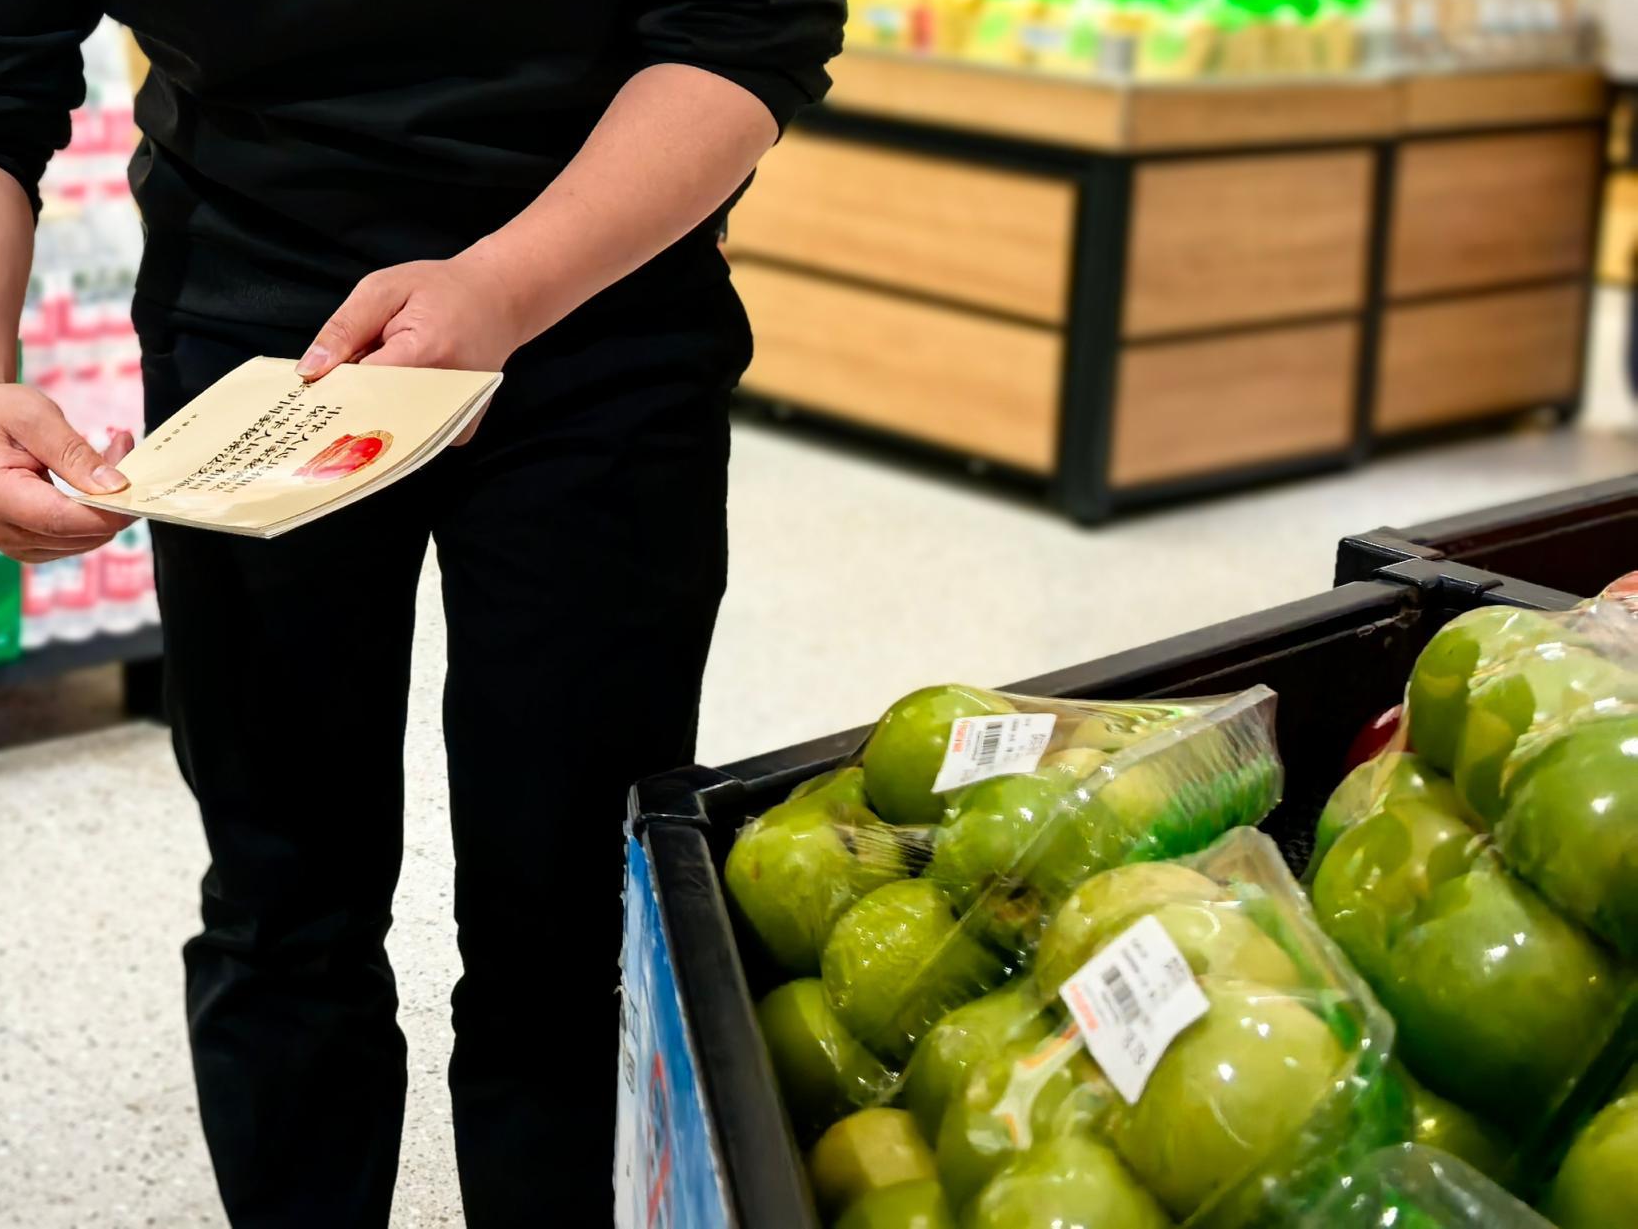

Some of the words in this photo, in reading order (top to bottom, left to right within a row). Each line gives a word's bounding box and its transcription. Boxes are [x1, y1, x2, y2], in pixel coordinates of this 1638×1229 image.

[188, 403, 305, 490] 中华人民共和国
[208, 405, 327, 491] 保守国家秘密法
[223, 406, 343, 493] 中华人民共和国
